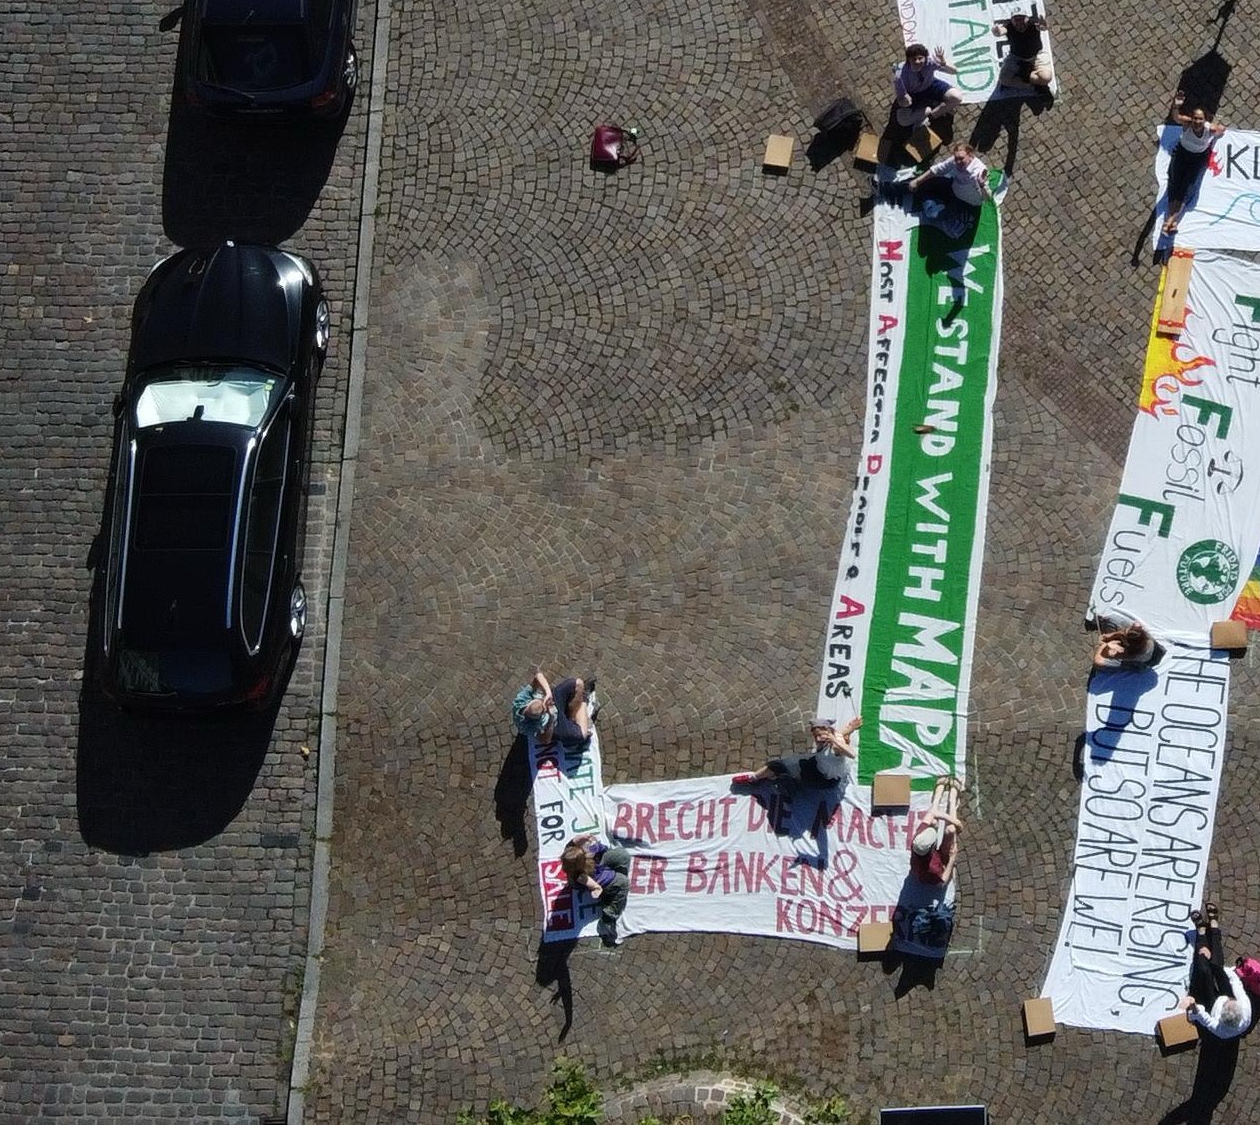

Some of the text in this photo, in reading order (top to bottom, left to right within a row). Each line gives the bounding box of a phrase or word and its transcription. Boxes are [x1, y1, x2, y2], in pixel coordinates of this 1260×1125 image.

[878, 240, 904, 303] MOST
[1162, 393, 1233, 502] Fossil
[875, 244, 990, 776] WE STAND WITH MAPA
[1100, 493, 1176, 606] Fuels
[1179, 554, 1194, 596] FUTURE
[1214, 542, 1238, 601] FRIDAYS FOR
[825, 594, 866, 700] AREAS
[1090, 703, 1156, 775] BUT
[1148, 702, 1222, 831] OCEANS
[539, 799, 565, 845] FOR
[613, 799, 737, 844] BRECHT
[1084, 774, 1147, 821] SO
[628, 849, 864, 902] ER BANKEN &
[1076, 821, 1139, 889] ARE
[1135, 828, 1202, 898] ARE
[541, 859, 574, 933] SALE
